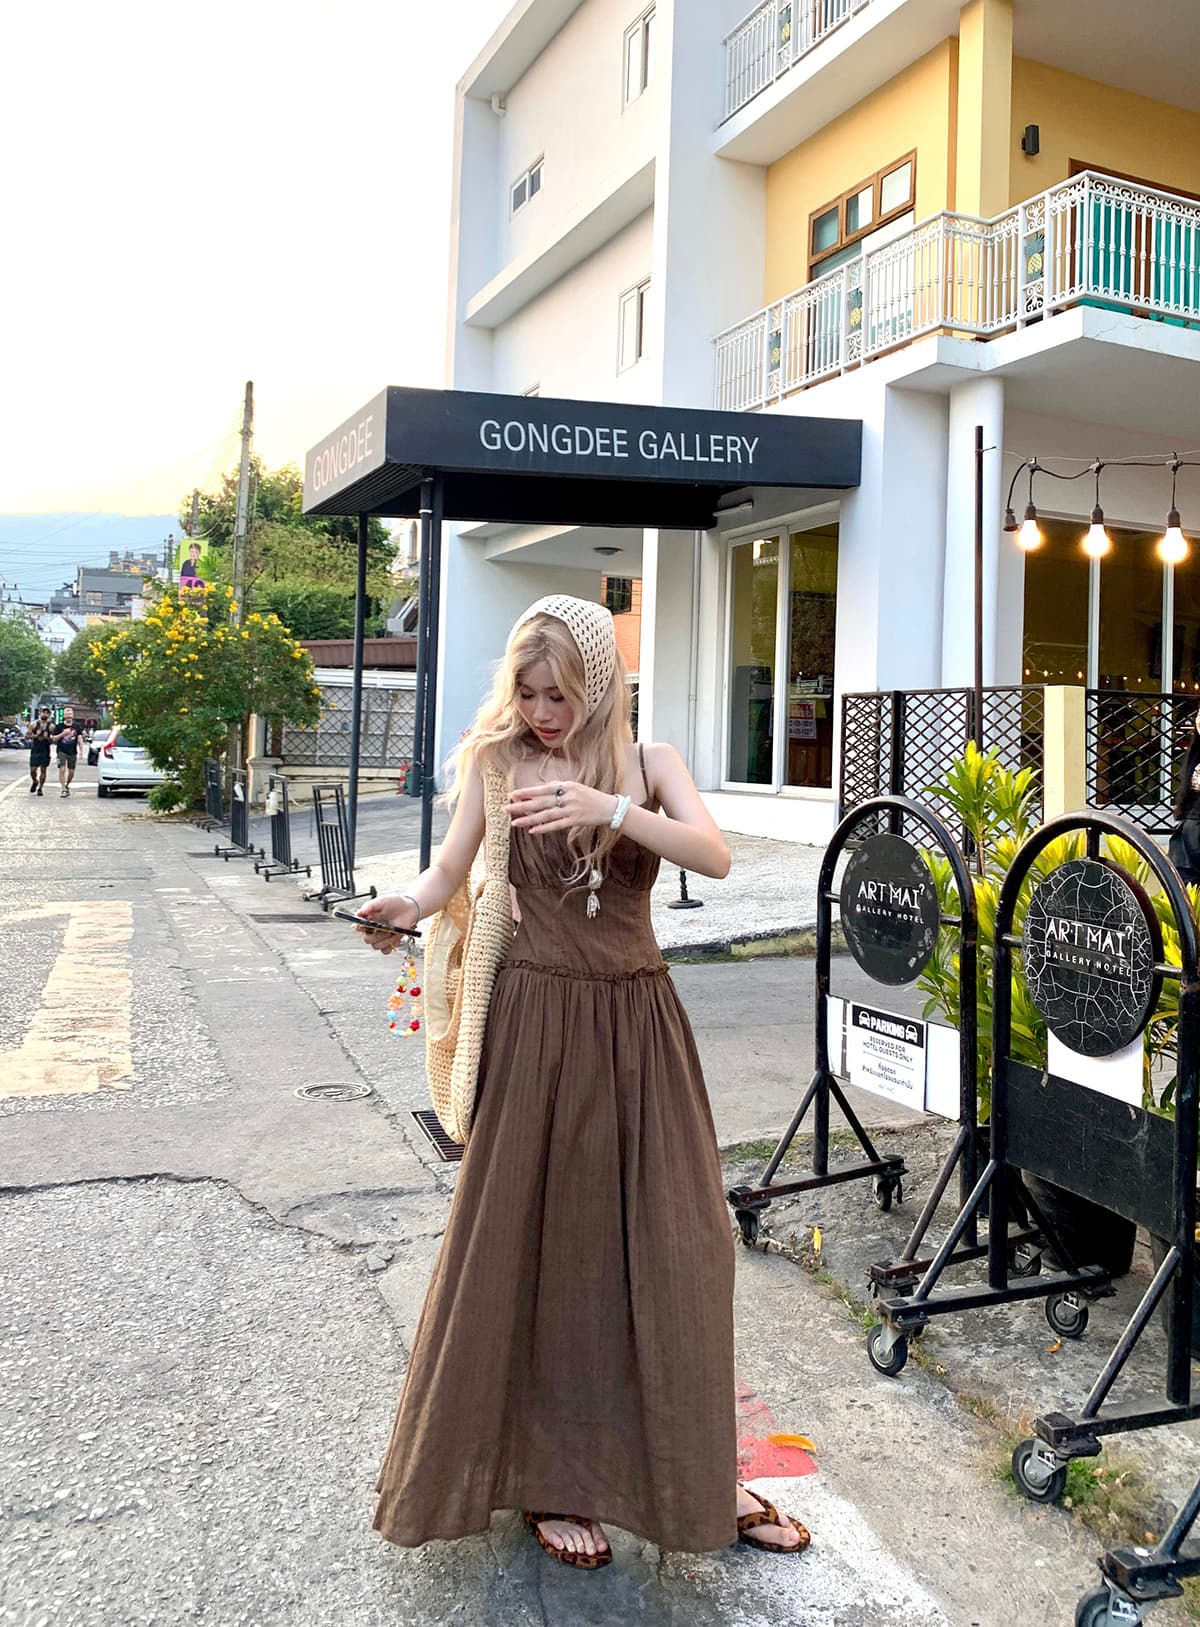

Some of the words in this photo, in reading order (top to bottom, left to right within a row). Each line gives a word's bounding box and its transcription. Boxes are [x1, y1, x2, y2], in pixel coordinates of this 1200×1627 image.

[312, 415, 374, 492] GONGDEE
[479, 419, 628, 458] GONGDEE
[638, 430, 760, 464] GALLERY
[857, 880, 887, 902] ART
[888, 882, 926, 910] MAI?
[855, 903, 892, 918] GALLERY
[896, 912, 925, 925] HOTEL
[1046, 918, 1083, 946] ART
[1086, 925, 1133, 958] MAI?
[1046, 949, 1091, 967] GALLERY
[1096, 961, 1132, 977] HOTEL
[870, 1016, 905, 1039] PARKING
[863, 1041, 878, 1052] HOTEL
[878, 1046, 899, 1059] GUESTS
[899, 1053, 913, 1063] ONLY
[869, 1035, 895, 1050] RESERVED
[895, 1044, 906, 1054] FOR
